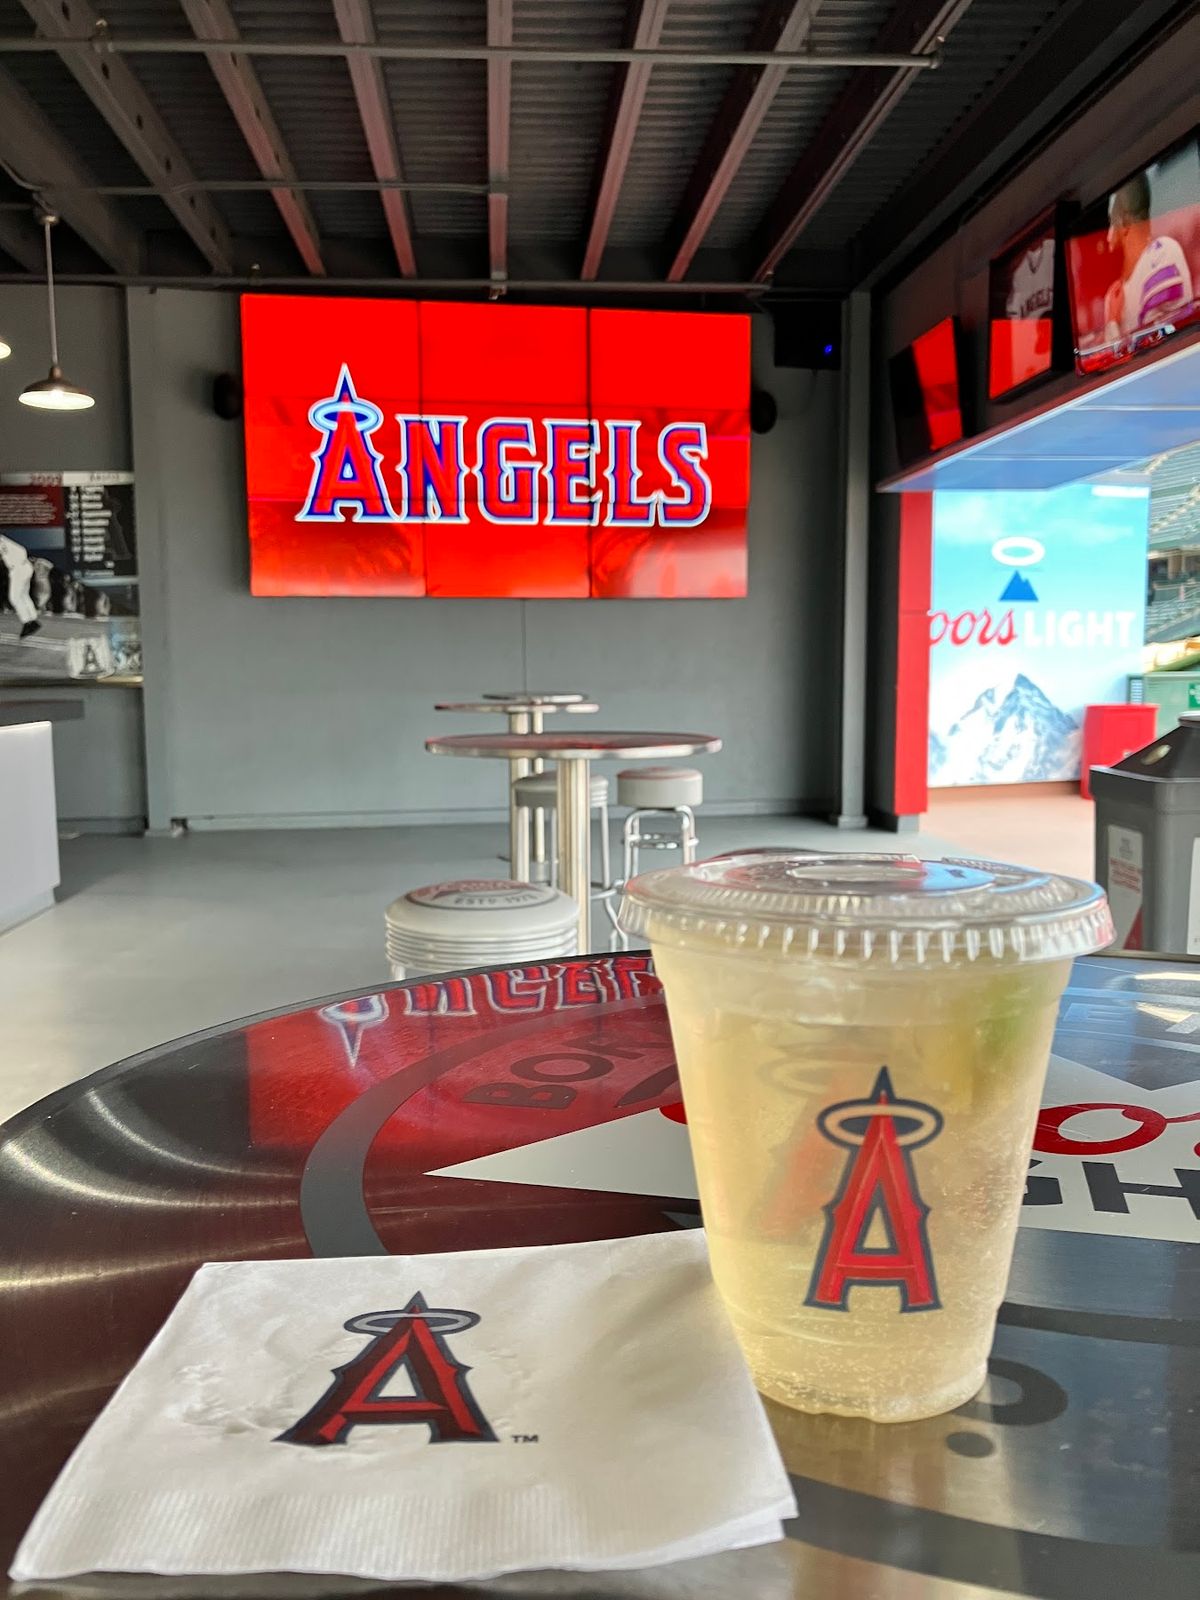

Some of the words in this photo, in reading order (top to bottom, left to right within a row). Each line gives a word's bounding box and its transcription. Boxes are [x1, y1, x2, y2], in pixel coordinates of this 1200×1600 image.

[295, 362, 711, 528] ANGELS
[927, 608, 1018, 647] oors
[1023, 610, 1136, 649] LIGHT
[462, 1020, 674, 1109] BOR
[803, 1065, 944, 1314] A
[270, 1290, 500, 1446] A
[510, 1433, 540, 1444] TM
